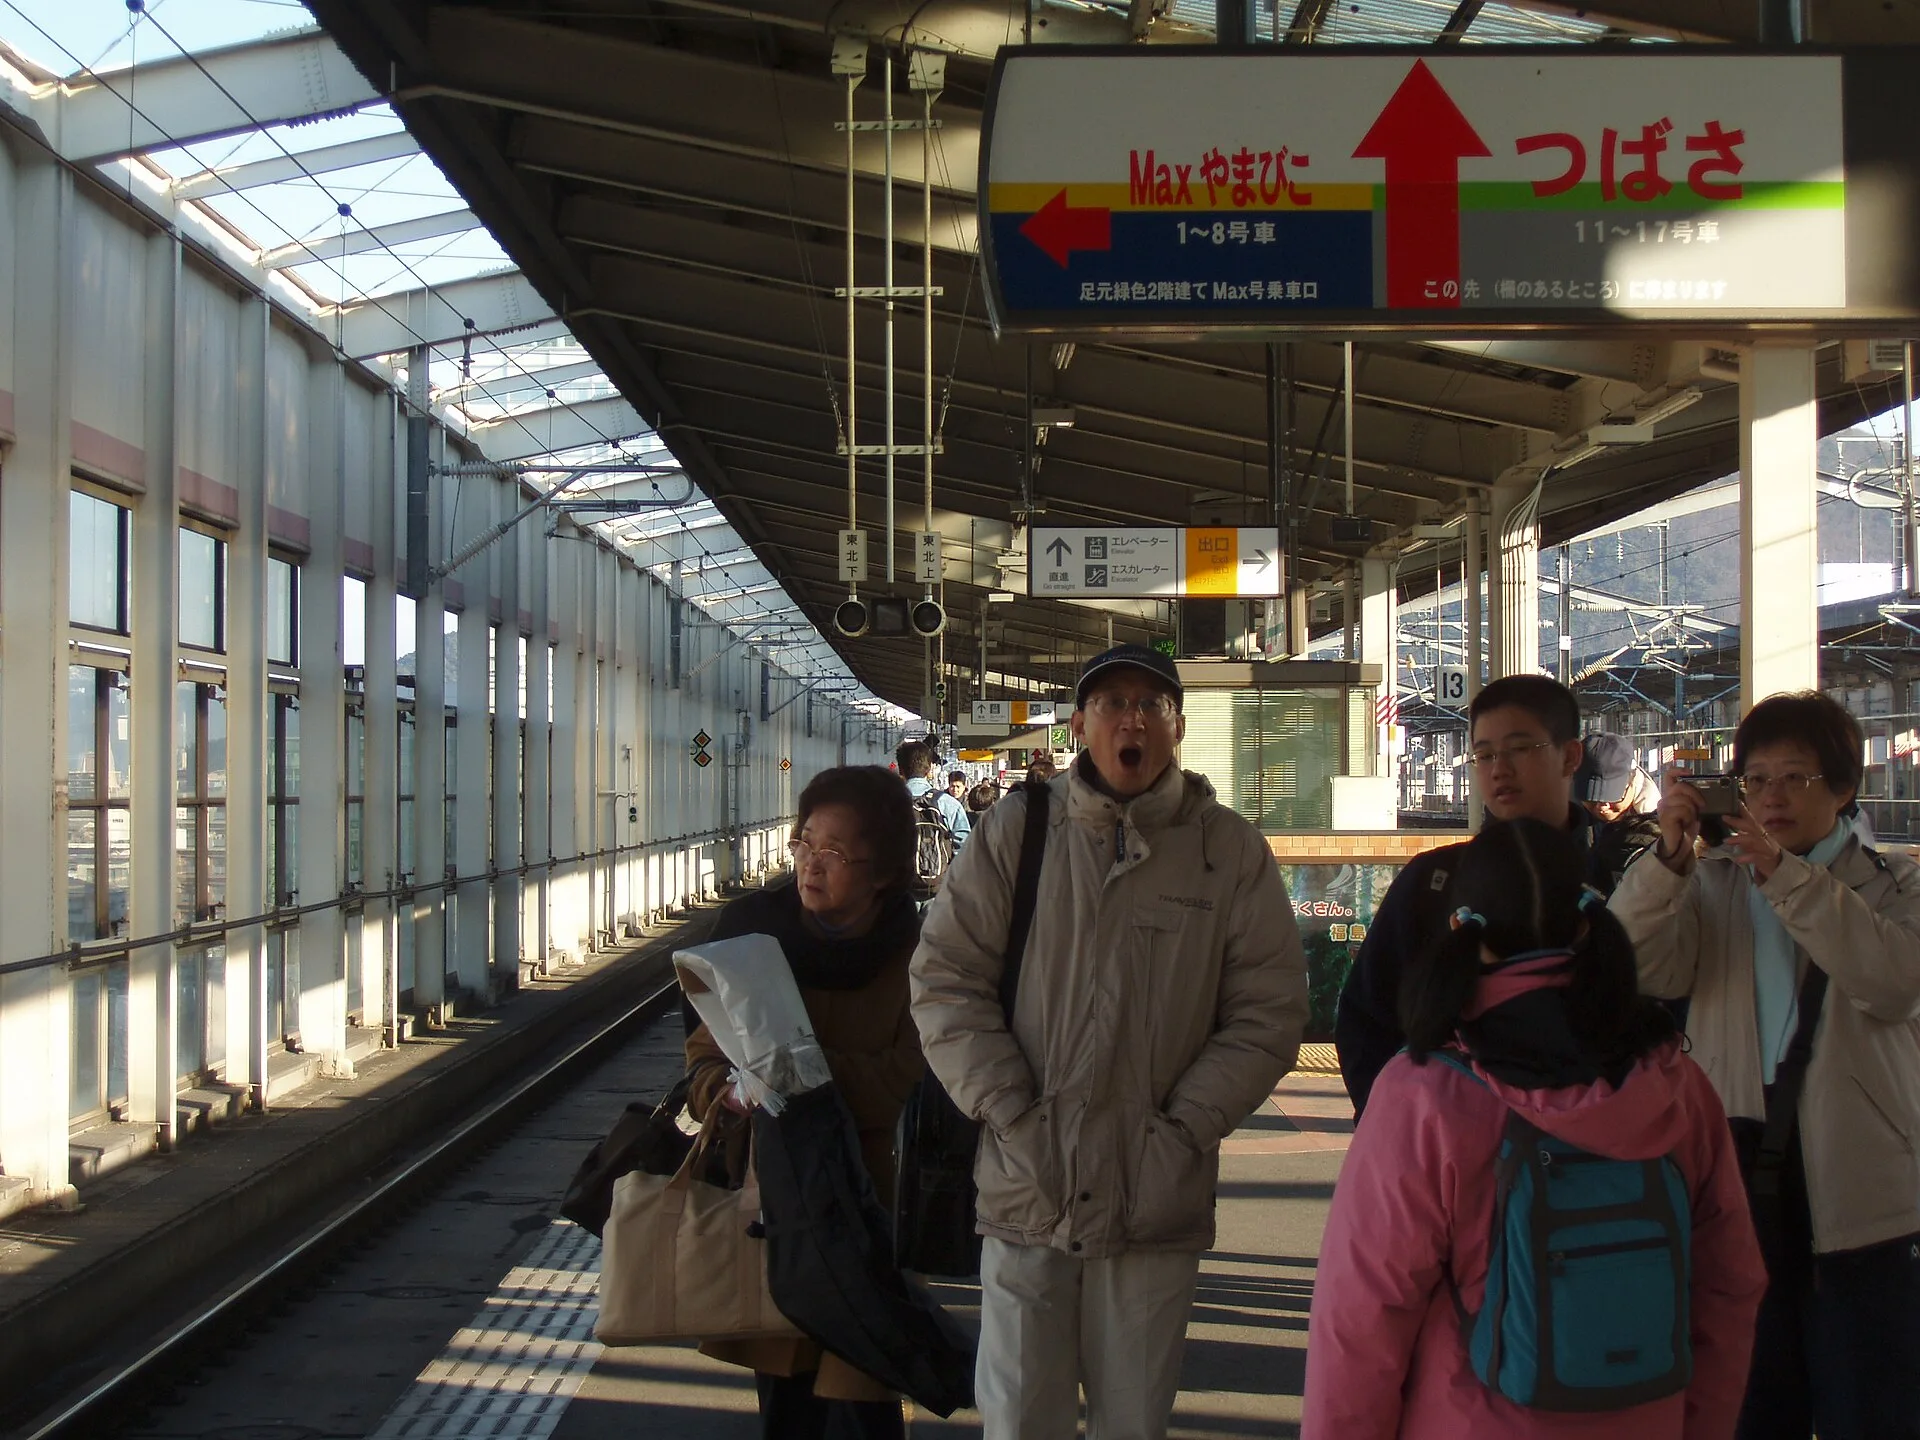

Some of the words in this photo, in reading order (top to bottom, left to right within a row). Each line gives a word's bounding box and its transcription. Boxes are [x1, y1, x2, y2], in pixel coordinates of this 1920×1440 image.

[1515, 116, 1745, 202] つばさ
[1129, 149, 1192, 207] Max
[1200, 145, 1312, 208] やまびこ
[1111, 537, 1169, 546] エレベーター
[1198, 536, 1229, 551] 出口
[846, 534, 858, 578] 東北下
[923, 535, 935, 579] 東北上
[1048, 572, 1069, 582] 直進
[1111, 564, 1169, 574] エスカレーター
[1442, 672, 1464, 699] 13
[1330, 923, 1367, 942] 福島
